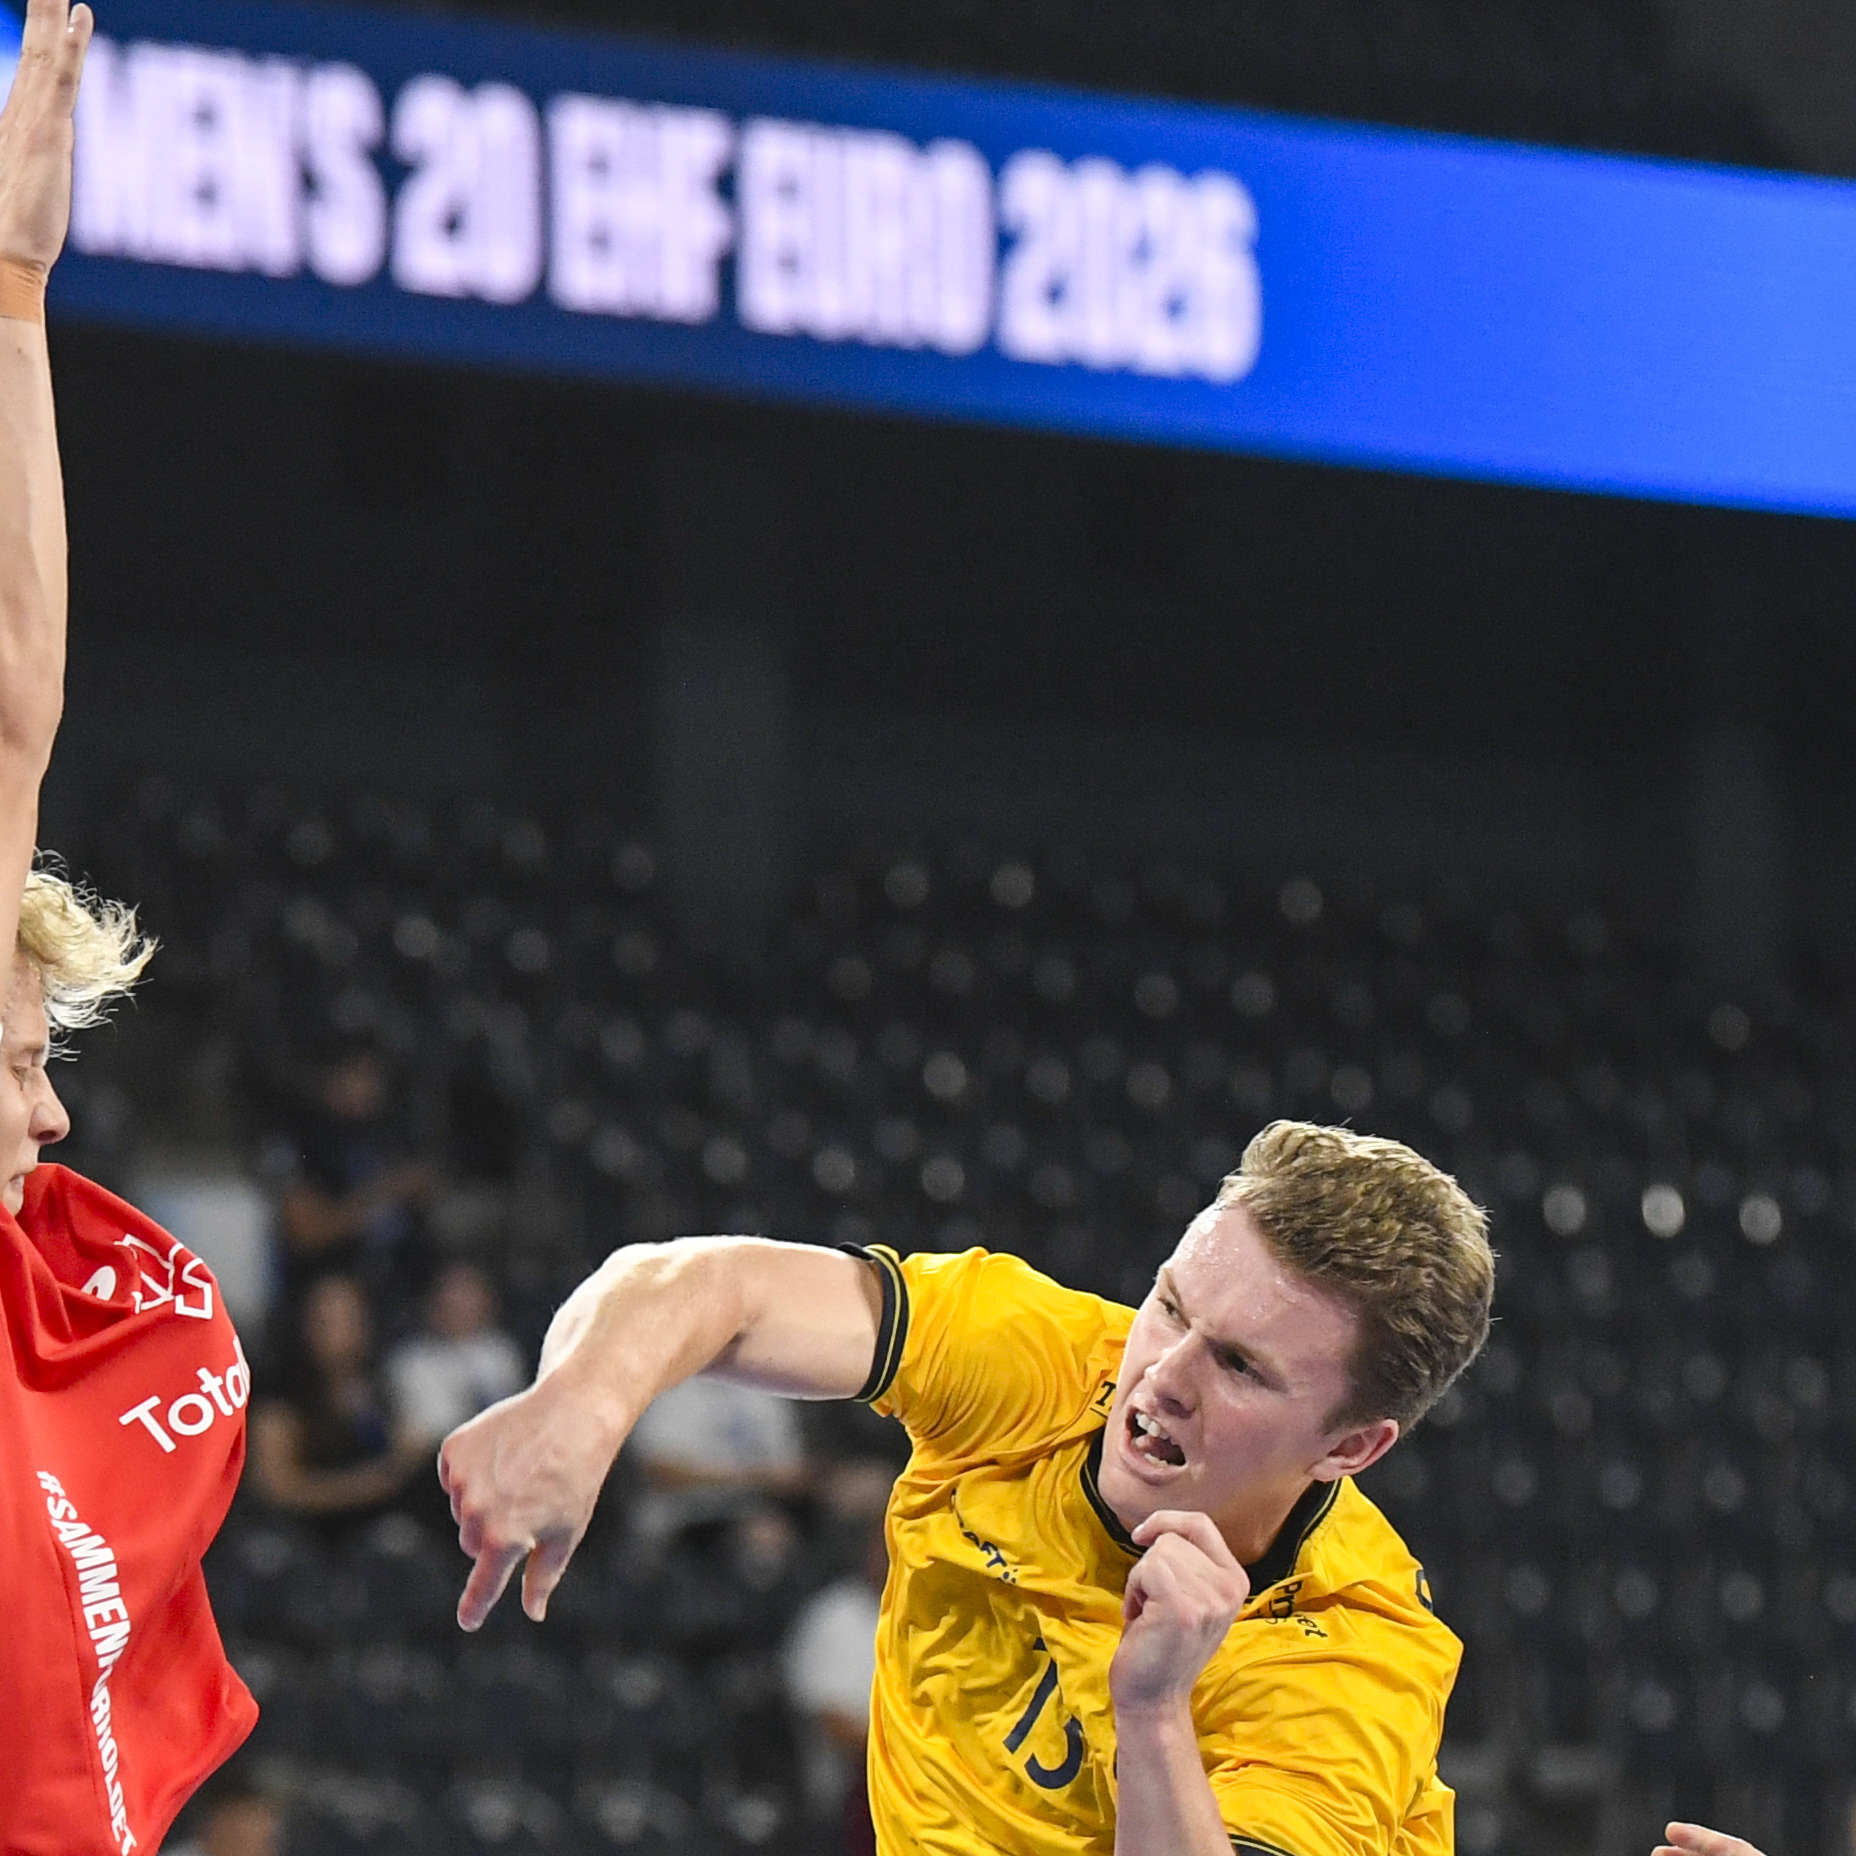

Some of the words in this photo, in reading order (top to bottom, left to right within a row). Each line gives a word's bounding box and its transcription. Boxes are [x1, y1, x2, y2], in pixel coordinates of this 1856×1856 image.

[393, 74, 541, 304] 20
[547, 92, 732, 324] EHF
[739, 115, 994, 357] EURO
[997, 148, 1261, 385] 2026
